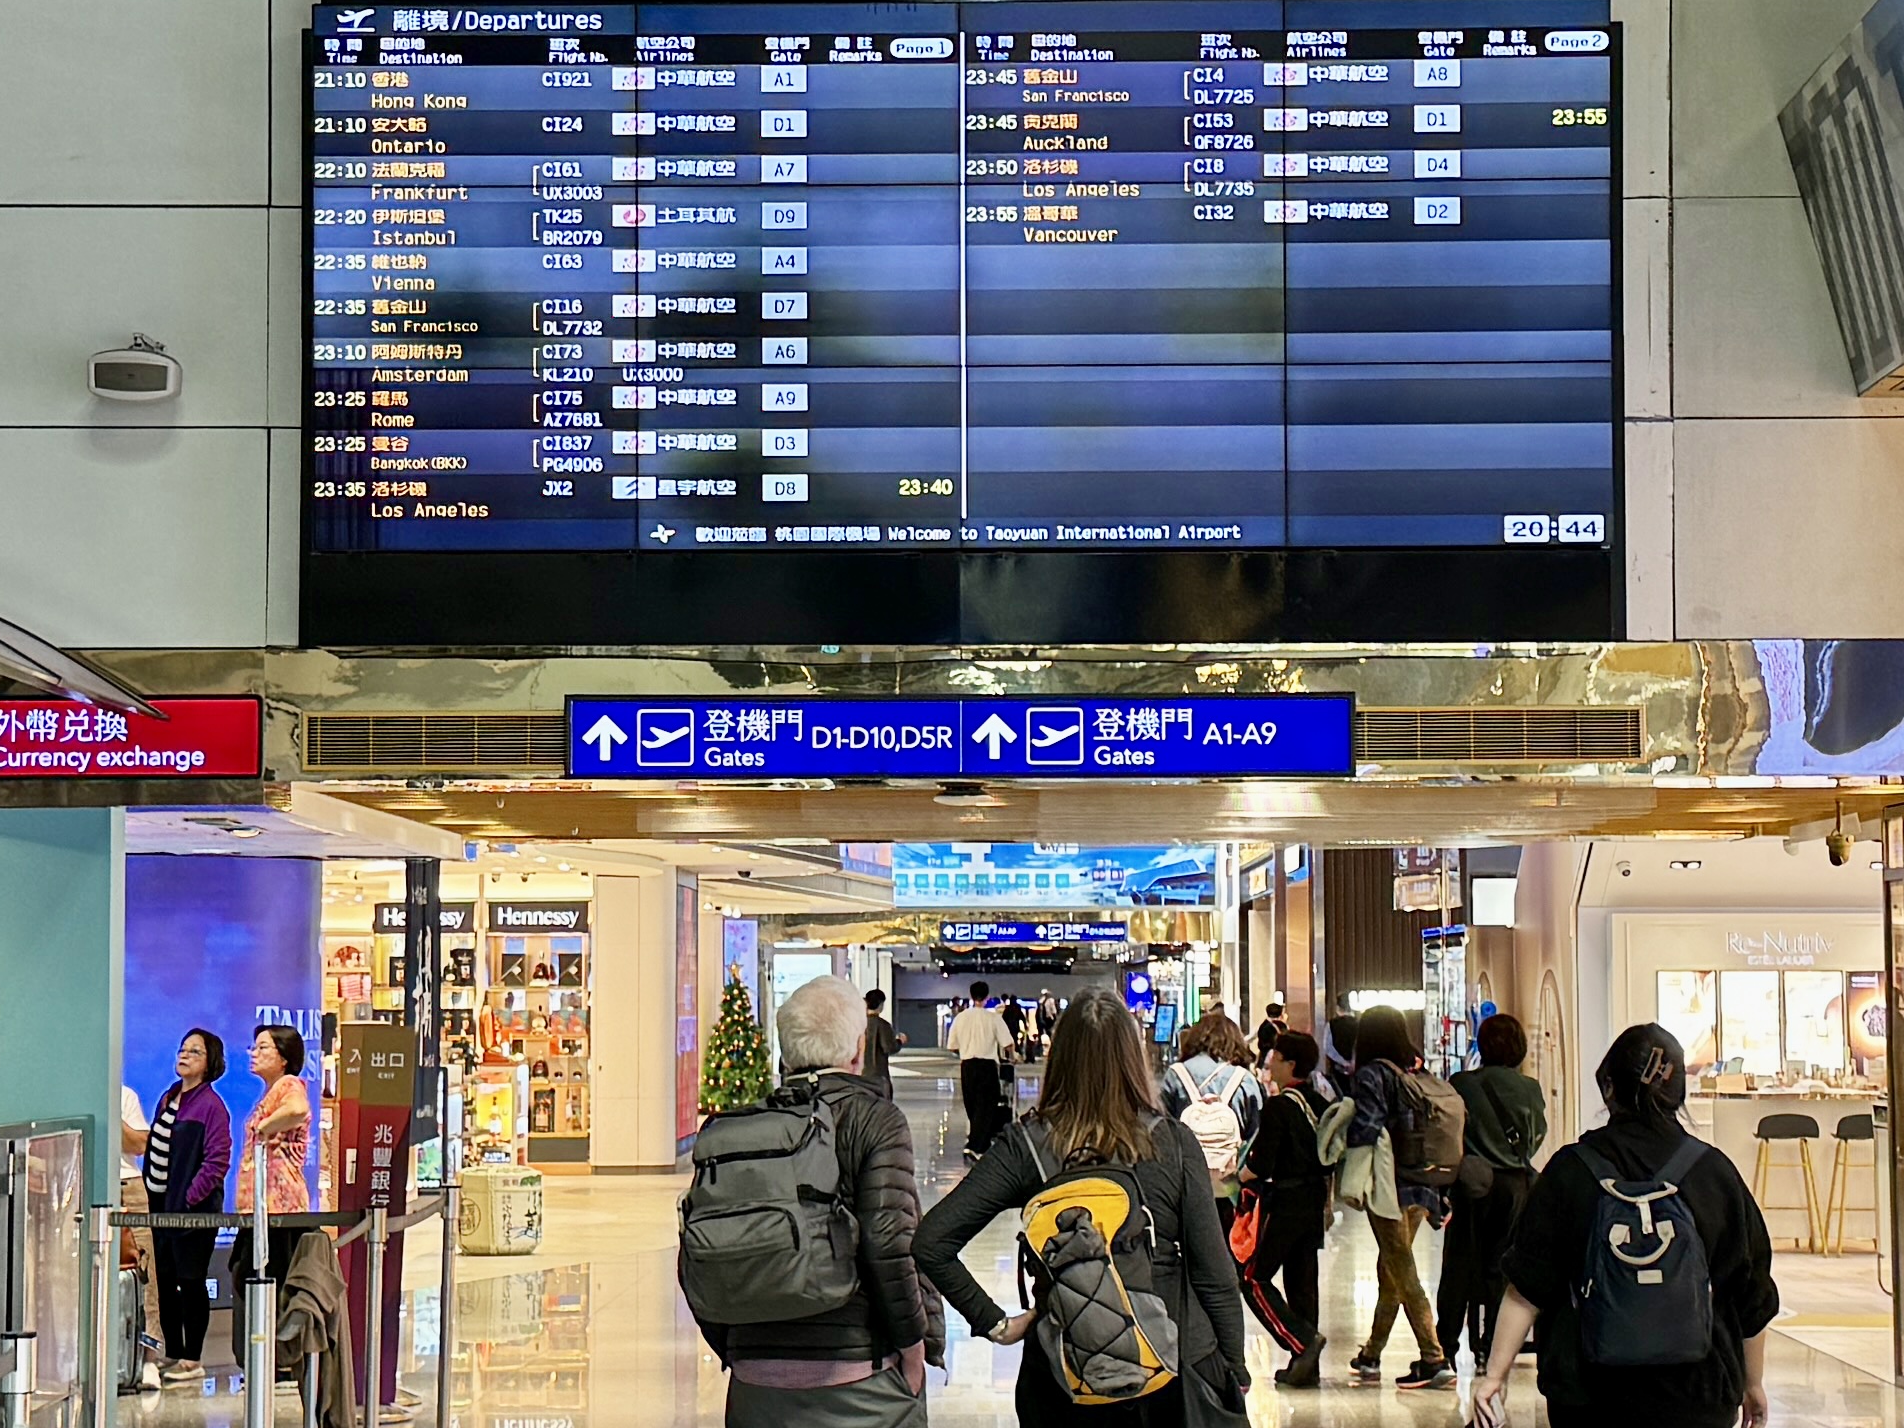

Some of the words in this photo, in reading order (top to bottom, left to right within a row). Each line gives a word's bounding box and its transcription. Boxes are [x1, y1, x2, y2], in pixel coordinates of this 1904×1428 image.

[393, 9, 603, 32] 離境/Departures
[1030, 48, 1114, 62] Destination
[1591, 34, 1602, 47] 2
[380, 52, 463, 64] Destination
[314, 72, 367, 88] 21:10
[371, 71, 409, 87] 香港
[542, 72, 592, 87] CI921
[774, 71, 795, 87] A1
[966, 70, 1019, 85] 23:45
[1193, 68, 1224, 83] CI4
[1427, 67, 1448, 82] A8
[371, 93, 414, 109] Hong
[424, 93, 467, 109] Kong
[1022, 89, 1047, 103] San
[1054, 89, 1130, 103] Francisco
[1193, 89, 1254, 104] DL7725
[314, 117, 367, 133] 21:10
[542, 117, 583, 133] CI24
[774, 117, 795, 133] D1
[966, 115, 1019, 131] 23:45
[1193, 114, 1234, 129] CI53
[1427, 113, 1448, 128] D1
[1552, 108, 1608, 126] 23:55
[371, 138, 446, 154] Ontario
[1022, 135, 1109, 151] Auckland
[314, 163, 367, 179] 22:10
[542, 162, 583, 177] CI61
[774, 162, 795, 177] A7
[966, 160, 1019, 176] 23:50
[1193, 159, 1224, 174] CI8
[1427, 158, 1448, 173] D4
[371, 185, 468, 201] Frankfurt
[542, 186, 603, 201] UX3003
[1022, 181, 1055, 198] Los
[1065, 181, 1140, 198] Angeles
[1193, 182, 1255, 197] DL7735
[314, 209, 367, 224] 22:20
[542, 209, 583, 224] TK25
[774, 209, 795, 224] D9
[966, 206, 1019, 222] 23:55
[1193, 205, 1234, 221] CI32
[1427, 204, 1448, 219] D2
[372, 229, 456, 246] Istanbul
[542, 230, 603, 245] BR2079
[1022, 227, 1119, 244] Vancouver
[314, 254, 367, 270] 22:35
[542, 254, 583, 269] CI63
[774, 254, 795, 270] A4
[372, 275, 435, 291] Vienna
[314, 299, 367, 315] 22:35
[542, 299, 583, 315] CI16
[774, 299, 795, 314] D7
[371, 320, 396, 333] San
[403, 320, 478, 333] Francisco
[542, 321, 603, 336] DL7732
[314, 345, 367, 360] 23:10
[542, 344, 583, 360] CI73
[774, 344, 795, 359] A6
[371, 366, 469, 383] Amsterdam
[542, 368, 593, 383] KL210
[314, 391, 367, 407] 23:25
[542, 391, 583, 406] CI75
[774, 391, 795, 406] A9
[371, 412, 414, 428] Rome
[314, 436, 367, 452] 23:25
[542, 436, 593, 451] CI837
[774, 436, 795, 451] D3
[542, 457, 603, 472] PG4906
[314, 482, 367, 498] 23:35
[542, 480, 573, 496] JX2
[774, 481, 795, 496] D8
[899, 479, 953, 496] 23:40
[371, 503, 404, 519] Los
[413, 503, 489, 519] Angeles
[887, 526, 951, 542] Welcome
[959, 527, 978, 541] to
[985, 526, 1049, 543] Taoyuan
[1056, 524, 1171, 541] International
[1178, 524, 1242, 541] Airport
[702, 707, 805, 744] 登機門
[812, 720, 954, 754] D1-D10,D5R
[1092, 706, 1194, 743] 登機門
[1202, 720, 1278, 748] A1-A9
[96, 746, 206, 774] exchange
[704, 746, 766, 769] Gates
[1094, 745, 1156, 768] Gates
[382, 907, 465, 930] Hessy
[497, 906, 580, 930] Hennessy
[370, 1052, 405, 1069] 出口
[370, 1123, 394, 1206] 兆豐銀行
